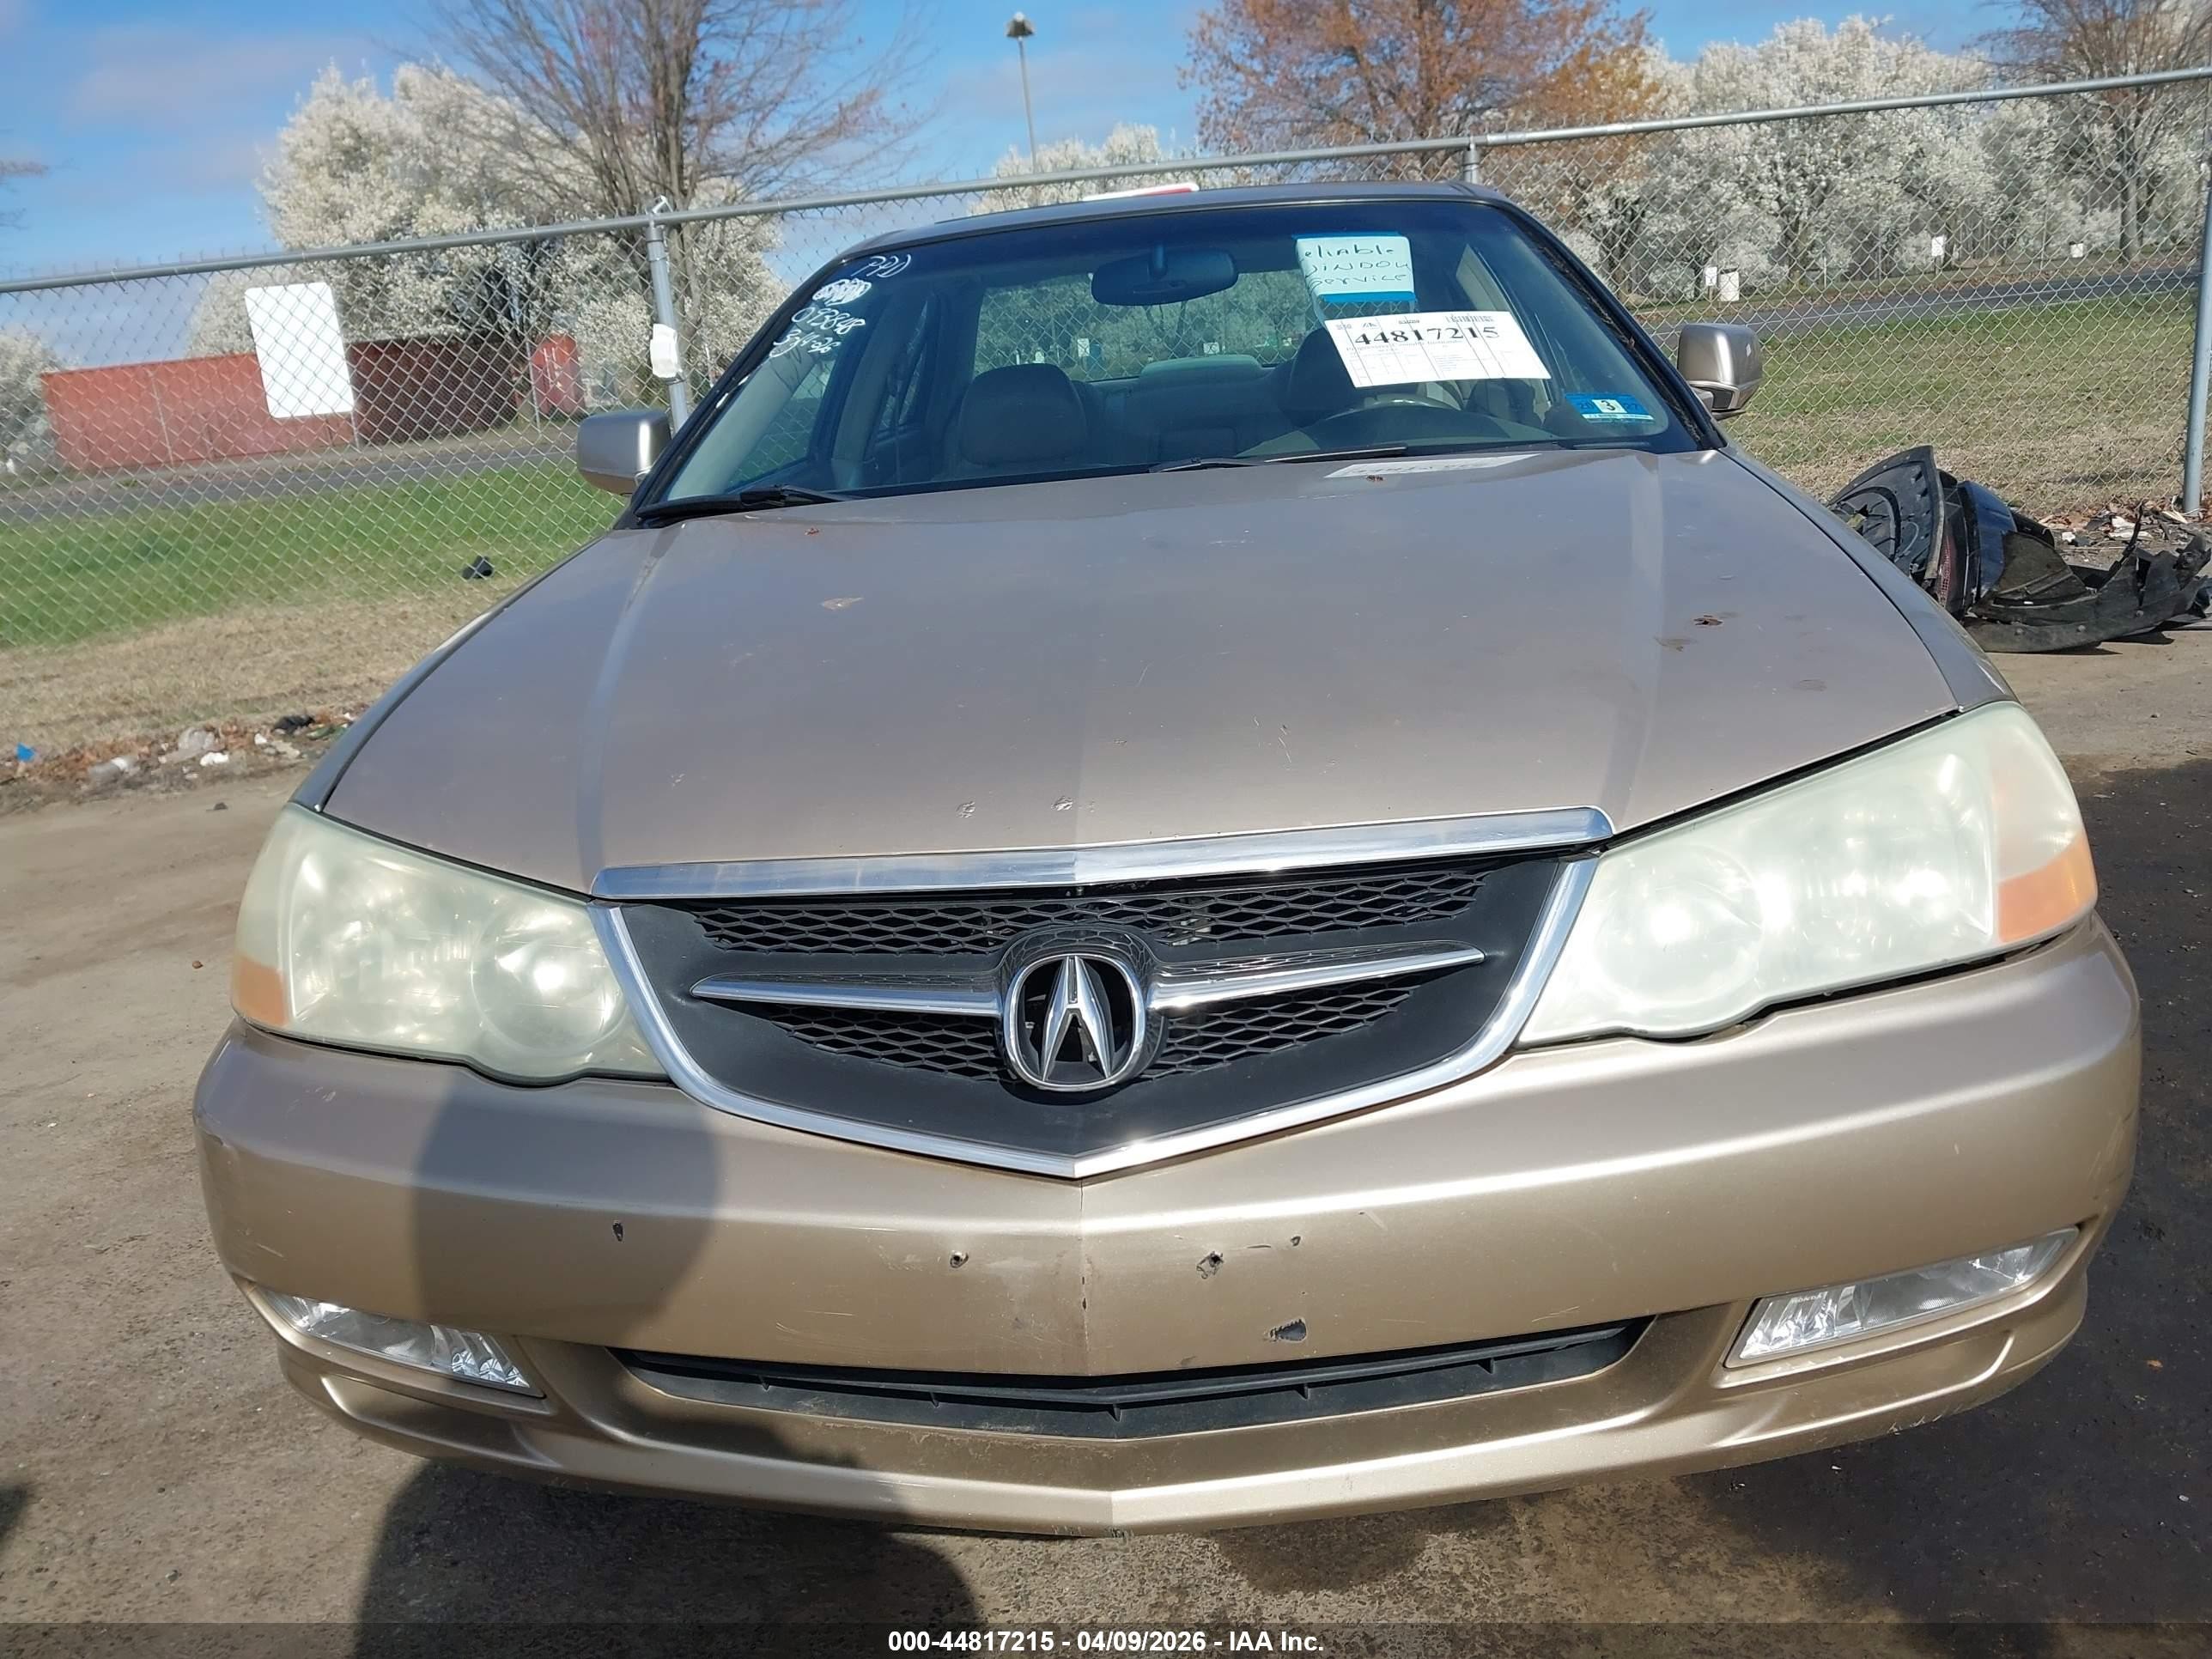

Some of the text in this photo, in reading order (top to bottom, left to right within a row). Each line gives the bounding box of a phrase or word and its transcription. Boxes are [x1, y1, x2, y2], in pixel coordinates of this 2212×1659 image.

[1299, 244, 1395, 262] eliable
[1354, 326, 1501, 345] 44817215
[1601, 400, 1616, 411] 3
